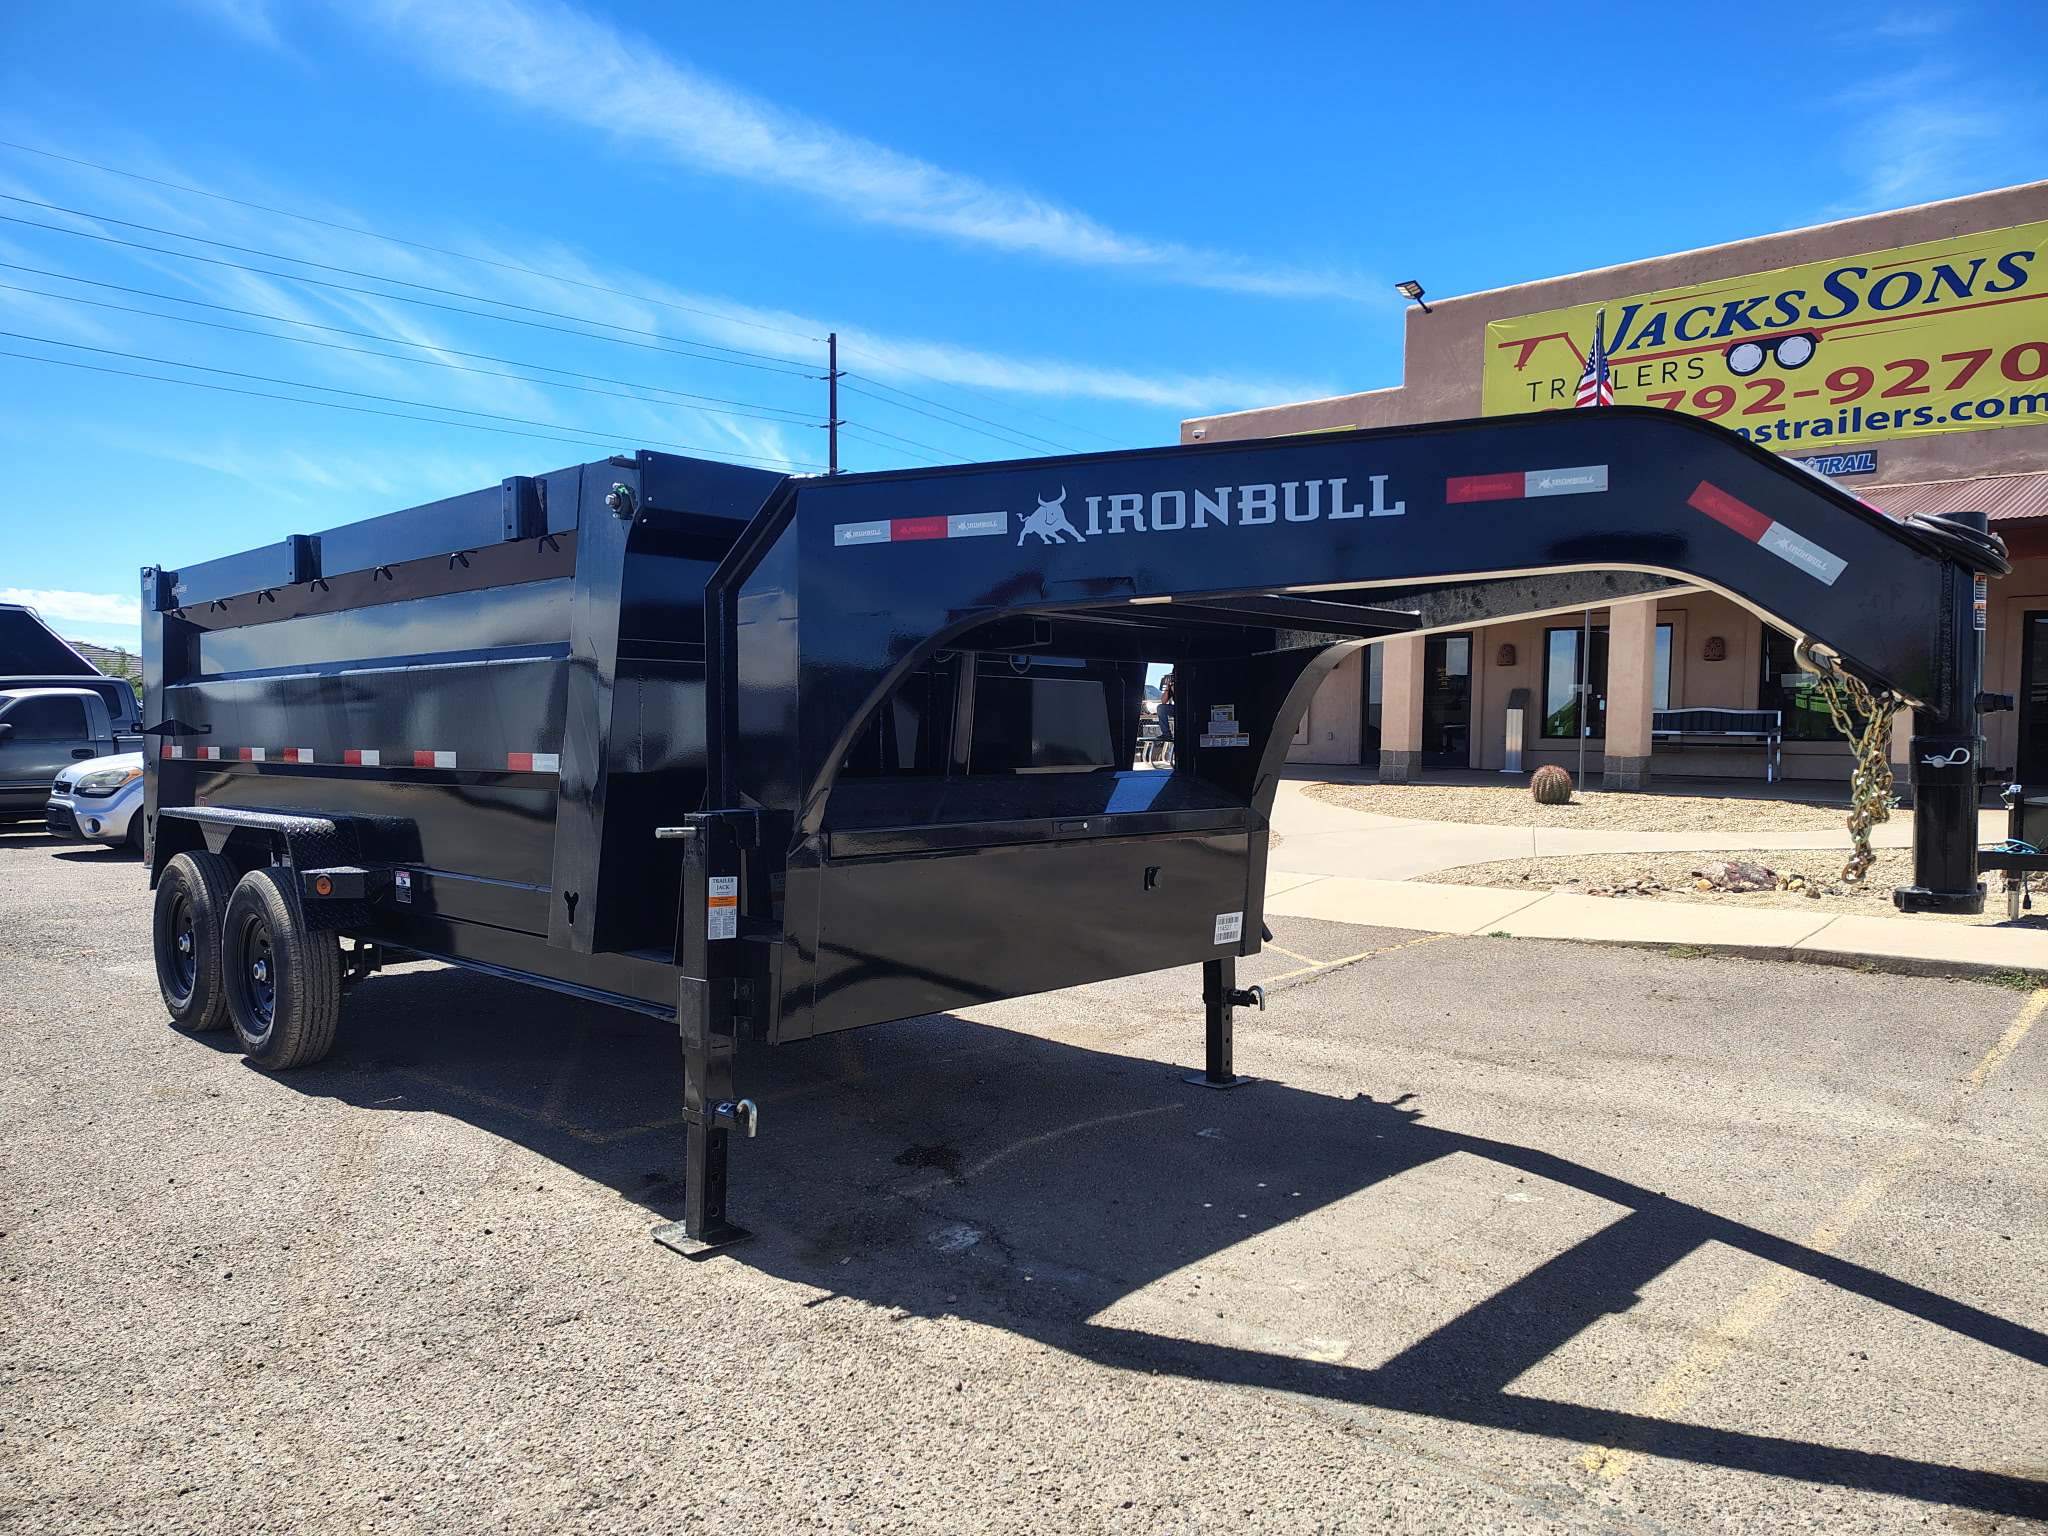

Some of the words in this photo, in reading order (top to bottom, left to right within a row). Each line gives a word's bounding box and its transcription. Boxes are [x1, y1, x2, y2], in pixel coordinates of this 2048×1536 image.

[1526, 357, 1705, 402] TRLERS
[1815, 454, 1876, 475] TRAIL
[1552, 474, 1596, 487] IRONBULL
[1085, 474, 1406, 535] IRONBULL
[852, 527, 882, 538] IRONBULL
[966, 519, 998, 530] IRONBULL
[1787, 543, 1829, 571] IRONBULL
